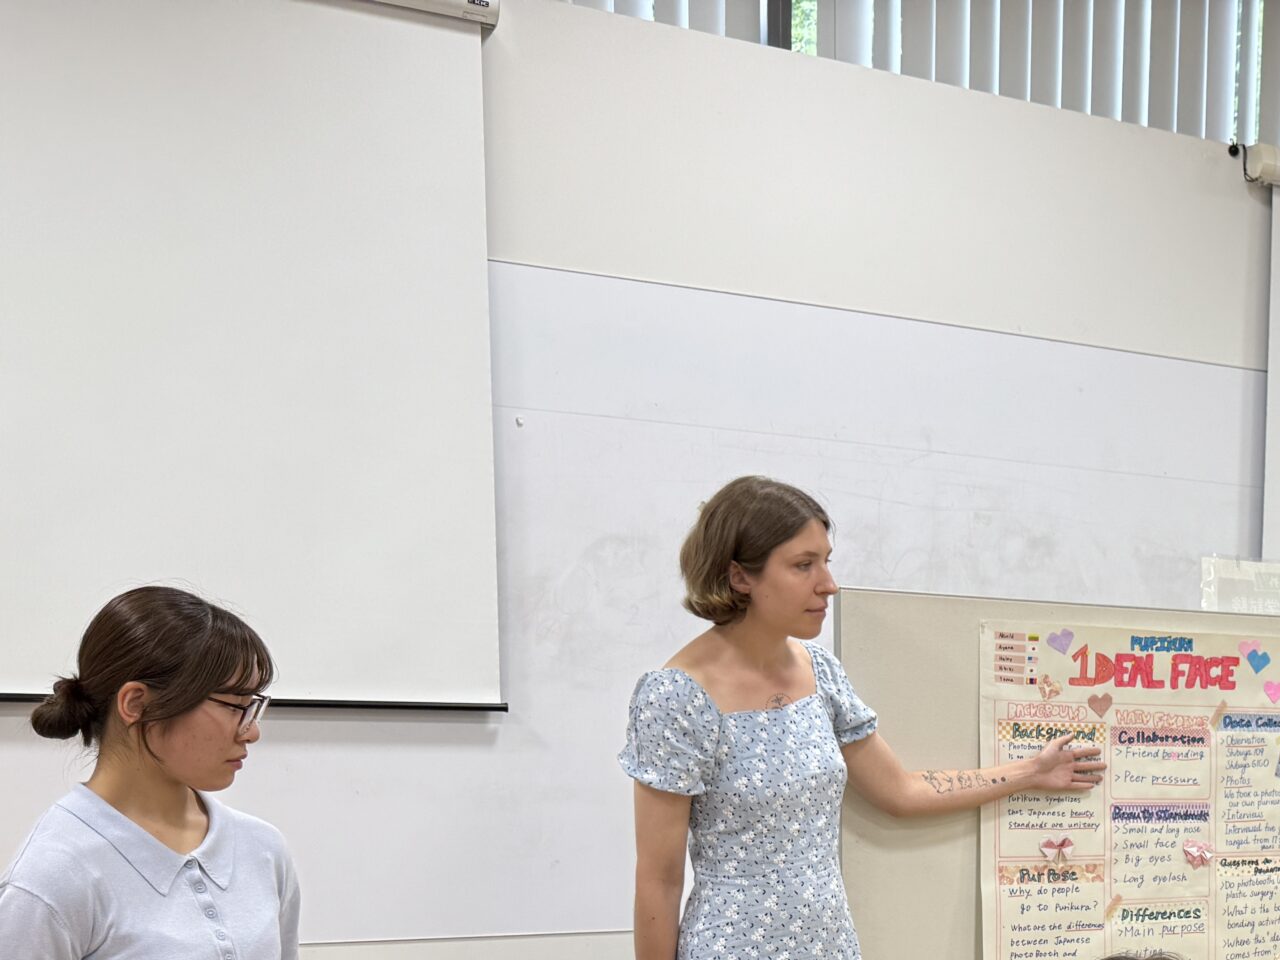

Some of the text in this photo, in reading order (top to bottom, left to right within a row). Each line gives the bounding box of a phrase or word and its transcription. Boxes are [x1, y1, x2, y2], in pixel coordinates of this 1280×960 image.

[1170, 653, 1240, 691] FACE
[1115, 709, 1150, 725] MAIN
[1222, 714, 1253, 729] Data
[1118, 730, 1205, 745] Collaboration
[1125, 746, 1160, 759] Friend
[1124, 770, 1199, 786] Peer pressure
[1225, 776, 1251, 786] Photos
[1224, 789, 1234, 799] We
[1236, 788, 1251, 798] took
[1008, 808, 1095, 819] that Japanese beauty
[1226, 809, 1264, 820] Interviews
[1122, 823, 1201, 838] Small and long nose
[1122, 838, 1177, 850] Small face
[1253, 834, 1270, 845] from
[1124, 854, 1172, 867] Big eyes
[1123, 872, 1188, 888] Long eyelash
[1225, 880, 1235, 890] Do
[1037, 887, 1048, 895] do
[1051, 886, 1080, 897] people
[1226, 890, 1248, 903] plastic
[1020, 903, 1031, 915] go
[1037, 903, 1048, 911] to
[1121, 907, 1201, 922] Differences
[1227, 903, 1249, 917] What
[1260, 903, 1270, 914] the
[1010, 923, 1032, 932] What
[1049, 922, 1062, 930] the
[1124, 926, 1154, 938] Main
[1227, 918, 1256, 934] bonding
[1010, 936, 1091, 947] between Japanese
[1227, 937, 1251, 948] Where
[1063, 949, 1078, 957] and
[1225, 952, 1251, 960] comes
